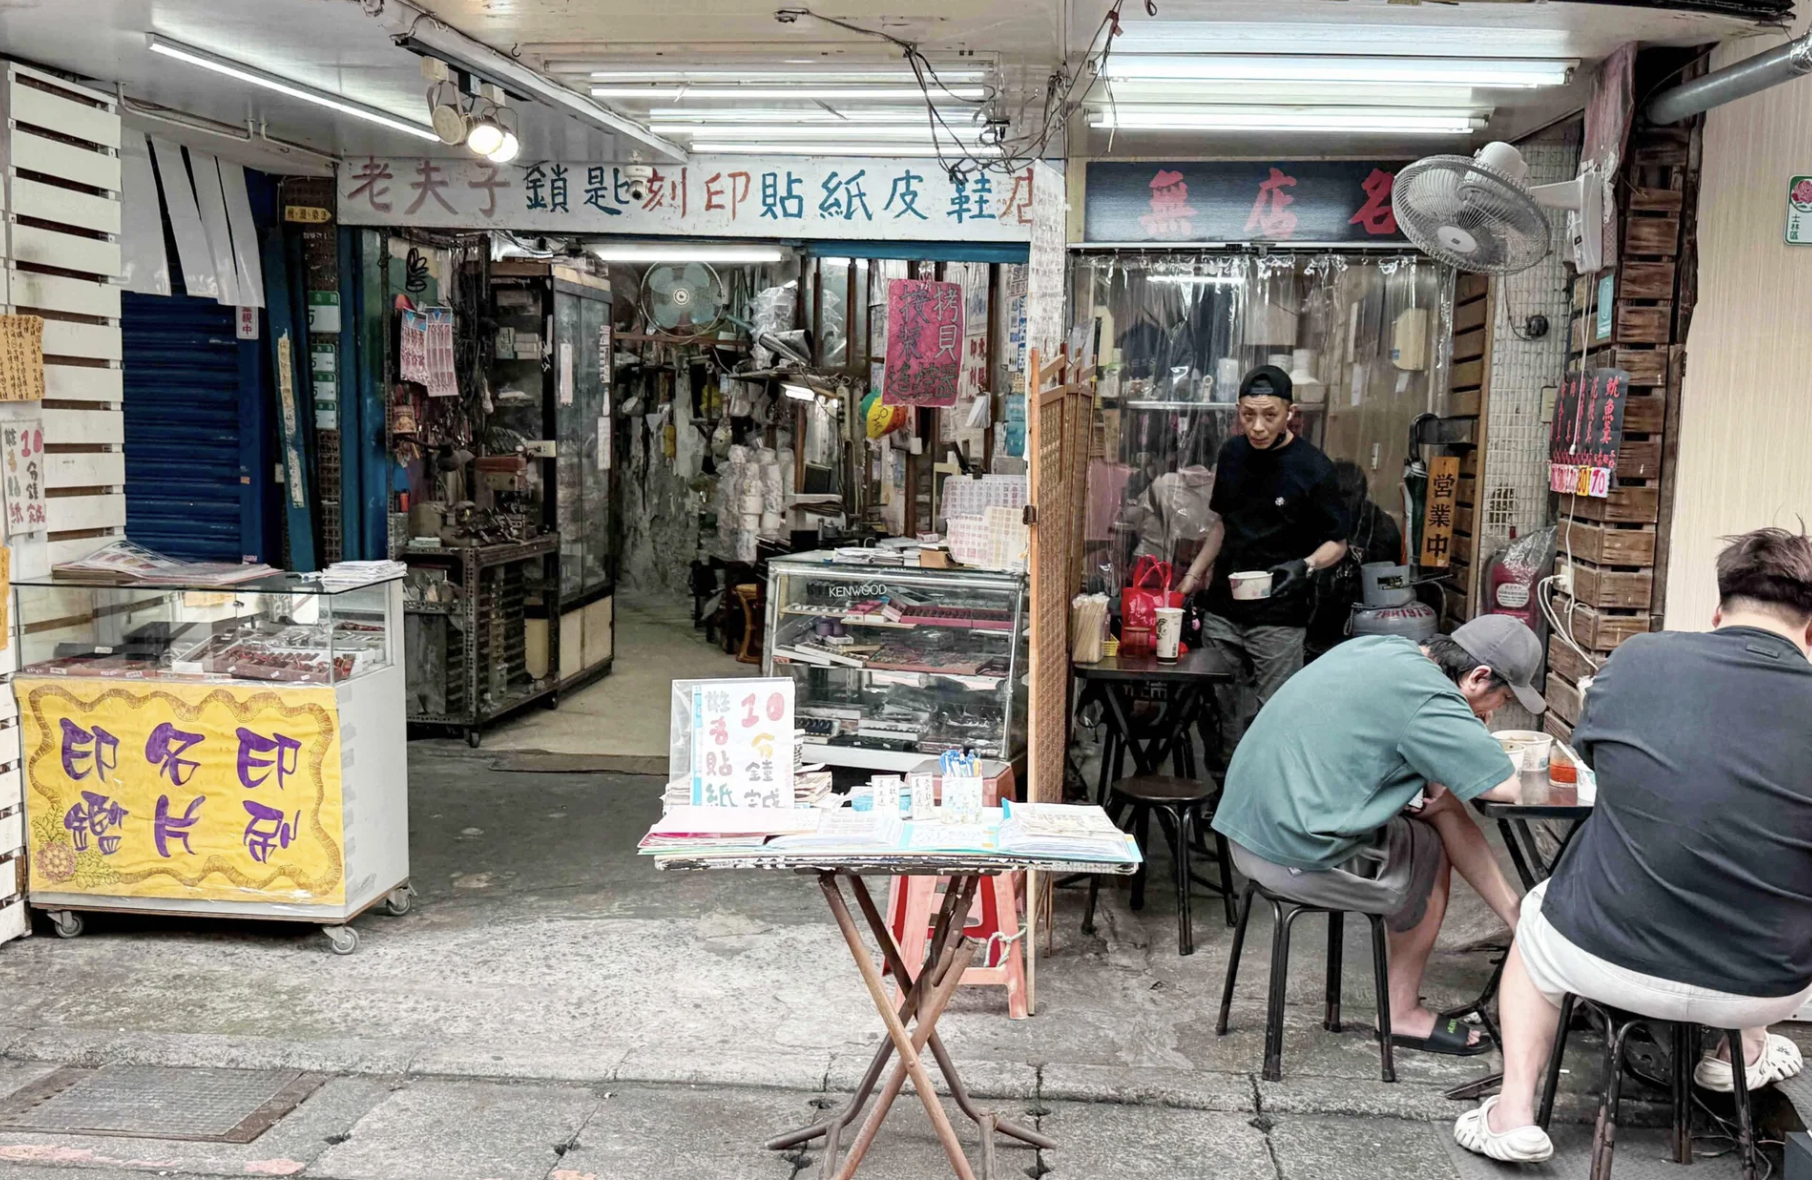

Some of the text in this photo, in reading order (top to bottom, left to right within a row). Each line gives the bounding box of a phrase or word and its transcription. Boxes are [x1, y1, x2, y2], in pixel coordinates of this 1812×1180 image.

[1790, 213, 1801, 240] 士林區
[932, 286, 960, 361] 拷貝
[828, 584, 888, 598] KENWOOD
[144, 721, 207, 858] 名片
